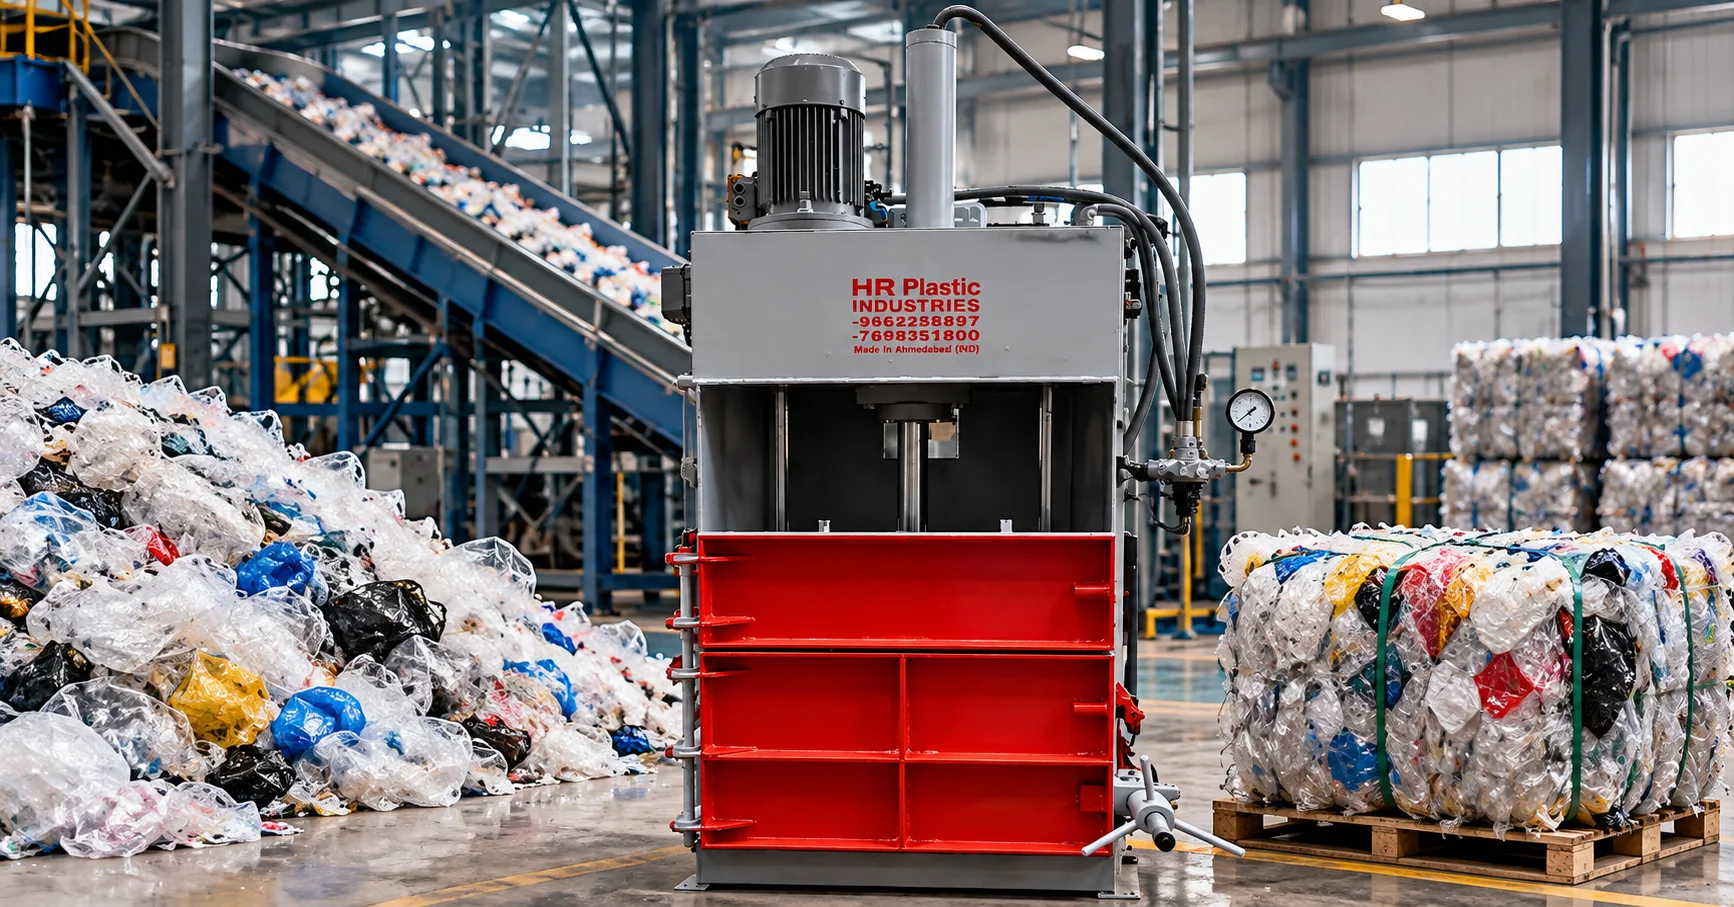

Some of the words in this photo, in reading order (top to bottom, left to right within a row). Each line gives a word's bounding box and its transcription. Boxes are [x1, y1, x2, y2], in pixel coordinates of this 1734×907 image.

[852, 278, 896, 297] HR
[903, 277, 981, 296] Plastic
[852, 298, 980, 313] INDUSTRIES
[852, 329, 980, 342] -7698351800
[853, 345, 880, 354] Made
